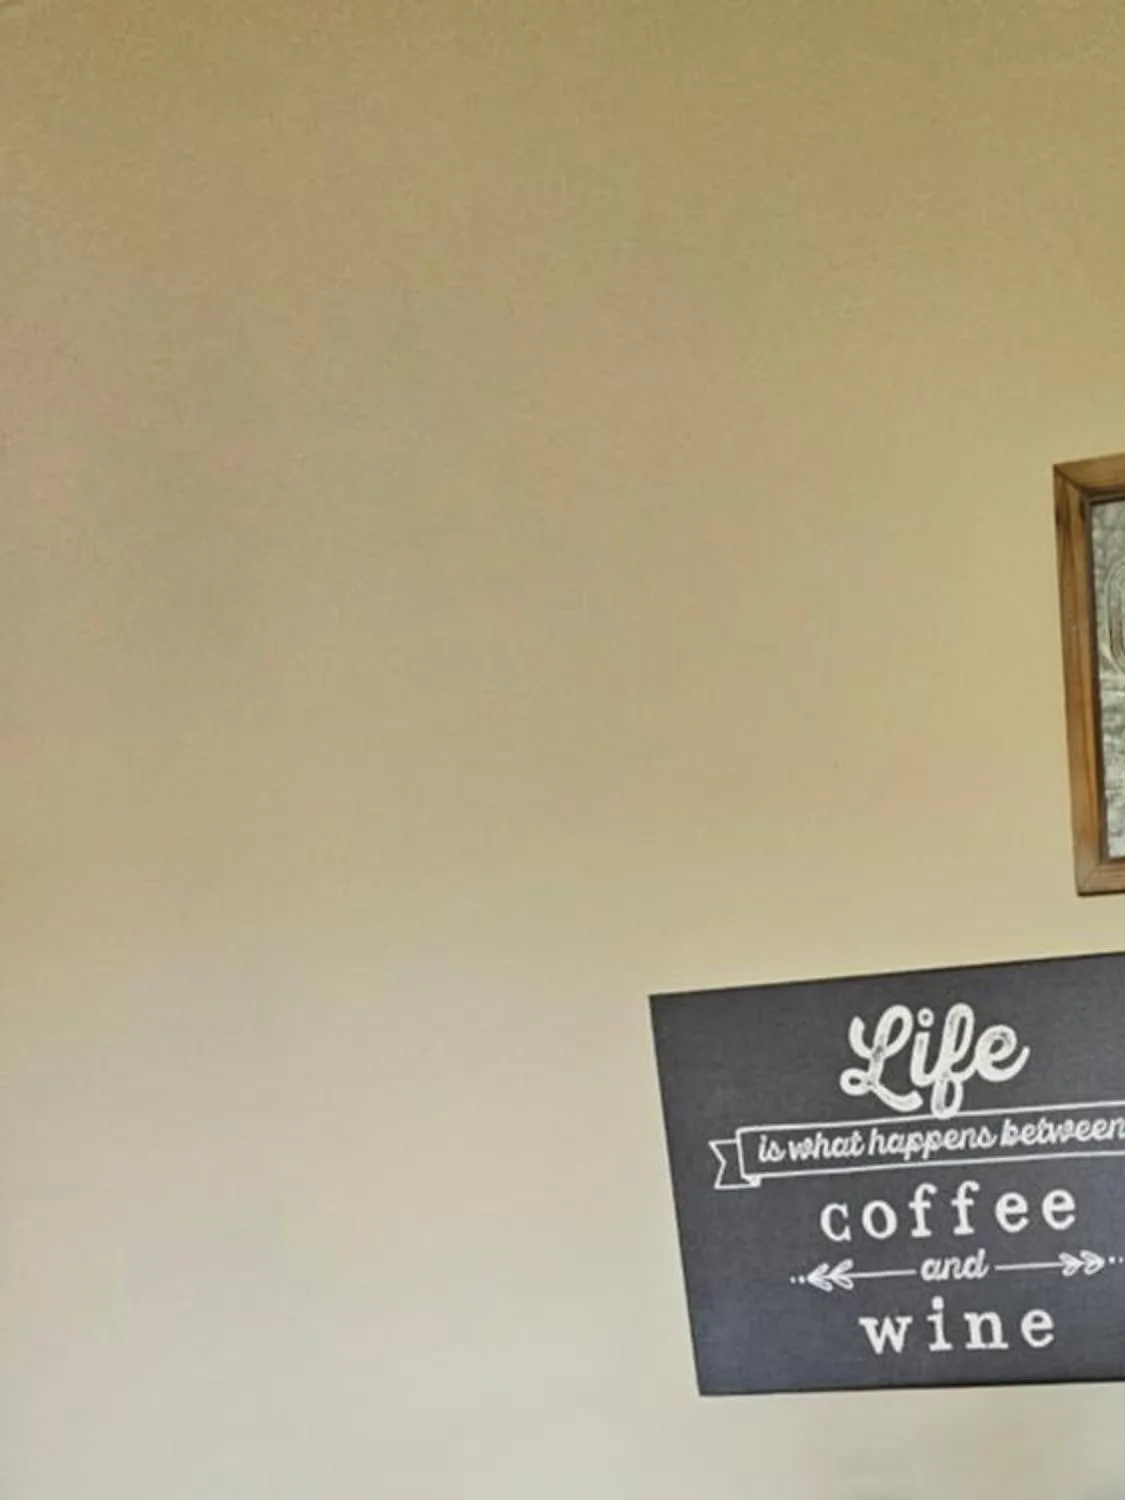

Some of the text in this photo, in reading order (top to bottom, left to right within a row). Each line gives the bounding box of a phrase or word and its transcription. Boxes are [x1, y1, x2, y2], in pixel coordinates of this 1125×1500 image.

[840, 1003, 1030, 1119] Life
[757, 1135, 785, 1163] is
[788, 1130, 866, 1161] what
[867, 1126, 997, 1160] happens
[820, 1181, 1078, 1242] coffee
[920, 1249, 990, 1282] and
[859, 1296, 1056, 1355] wine
